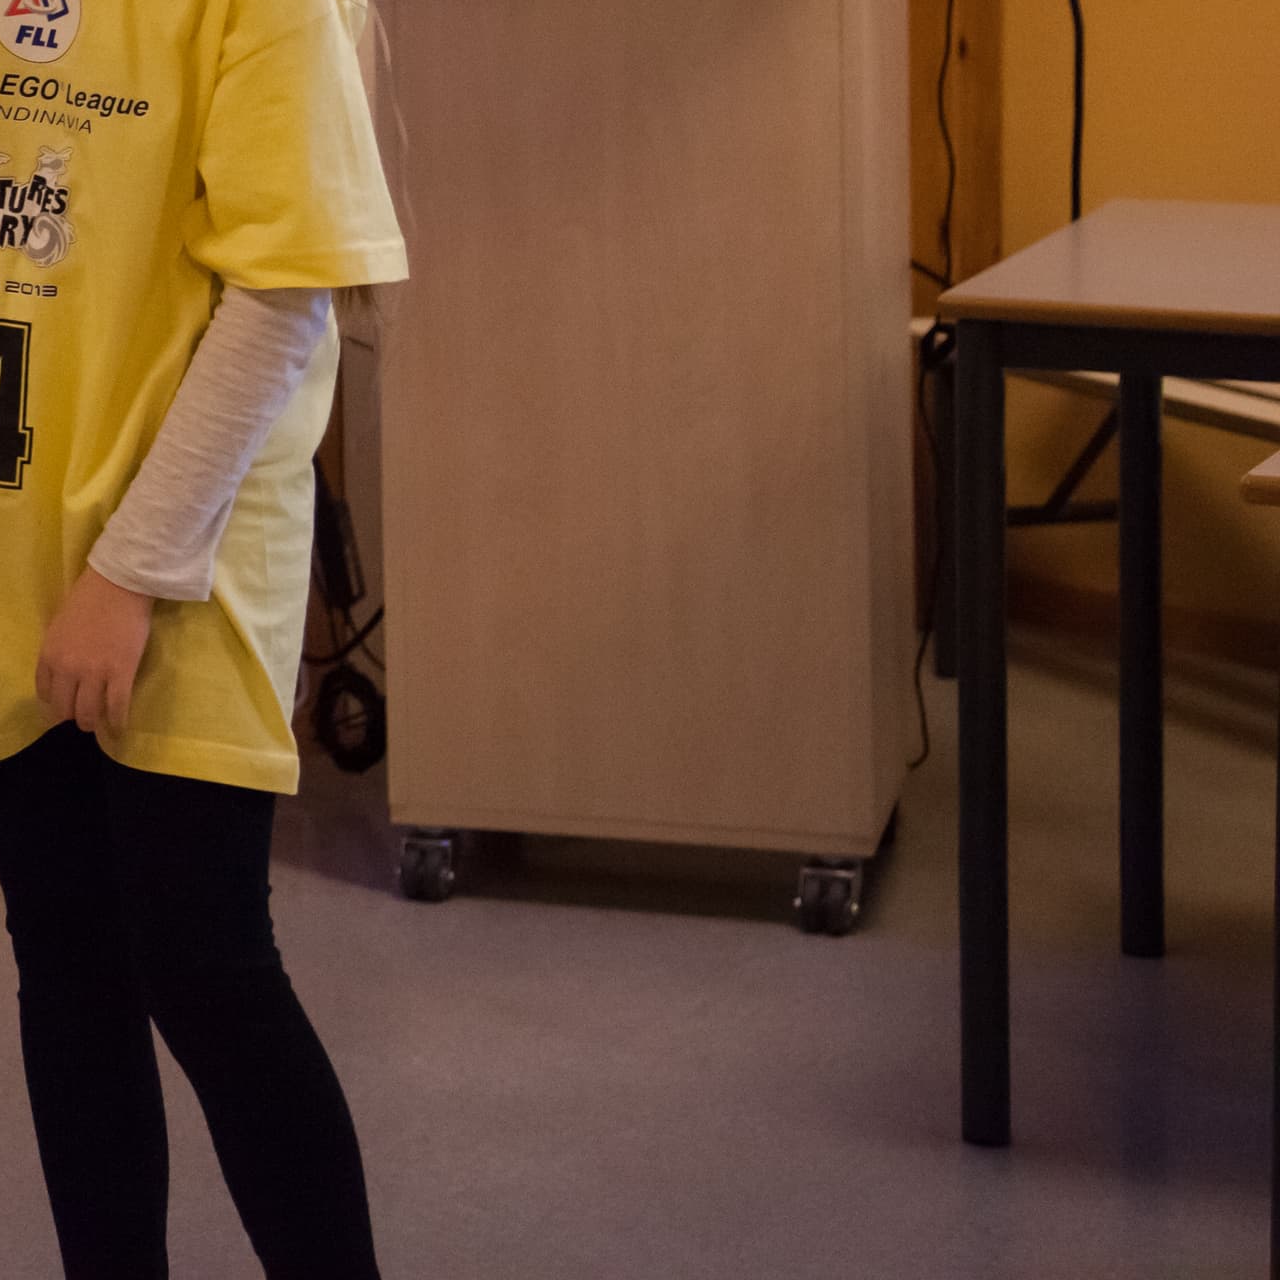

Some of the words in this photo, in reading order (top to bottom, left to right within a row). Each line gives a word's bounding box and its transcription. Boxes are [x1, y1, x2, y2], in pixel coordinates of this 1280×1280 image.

[16, 25, 58, 48] FLL
[66, 84, 149, 117] League
[5, 281, 58, 297] 2013
